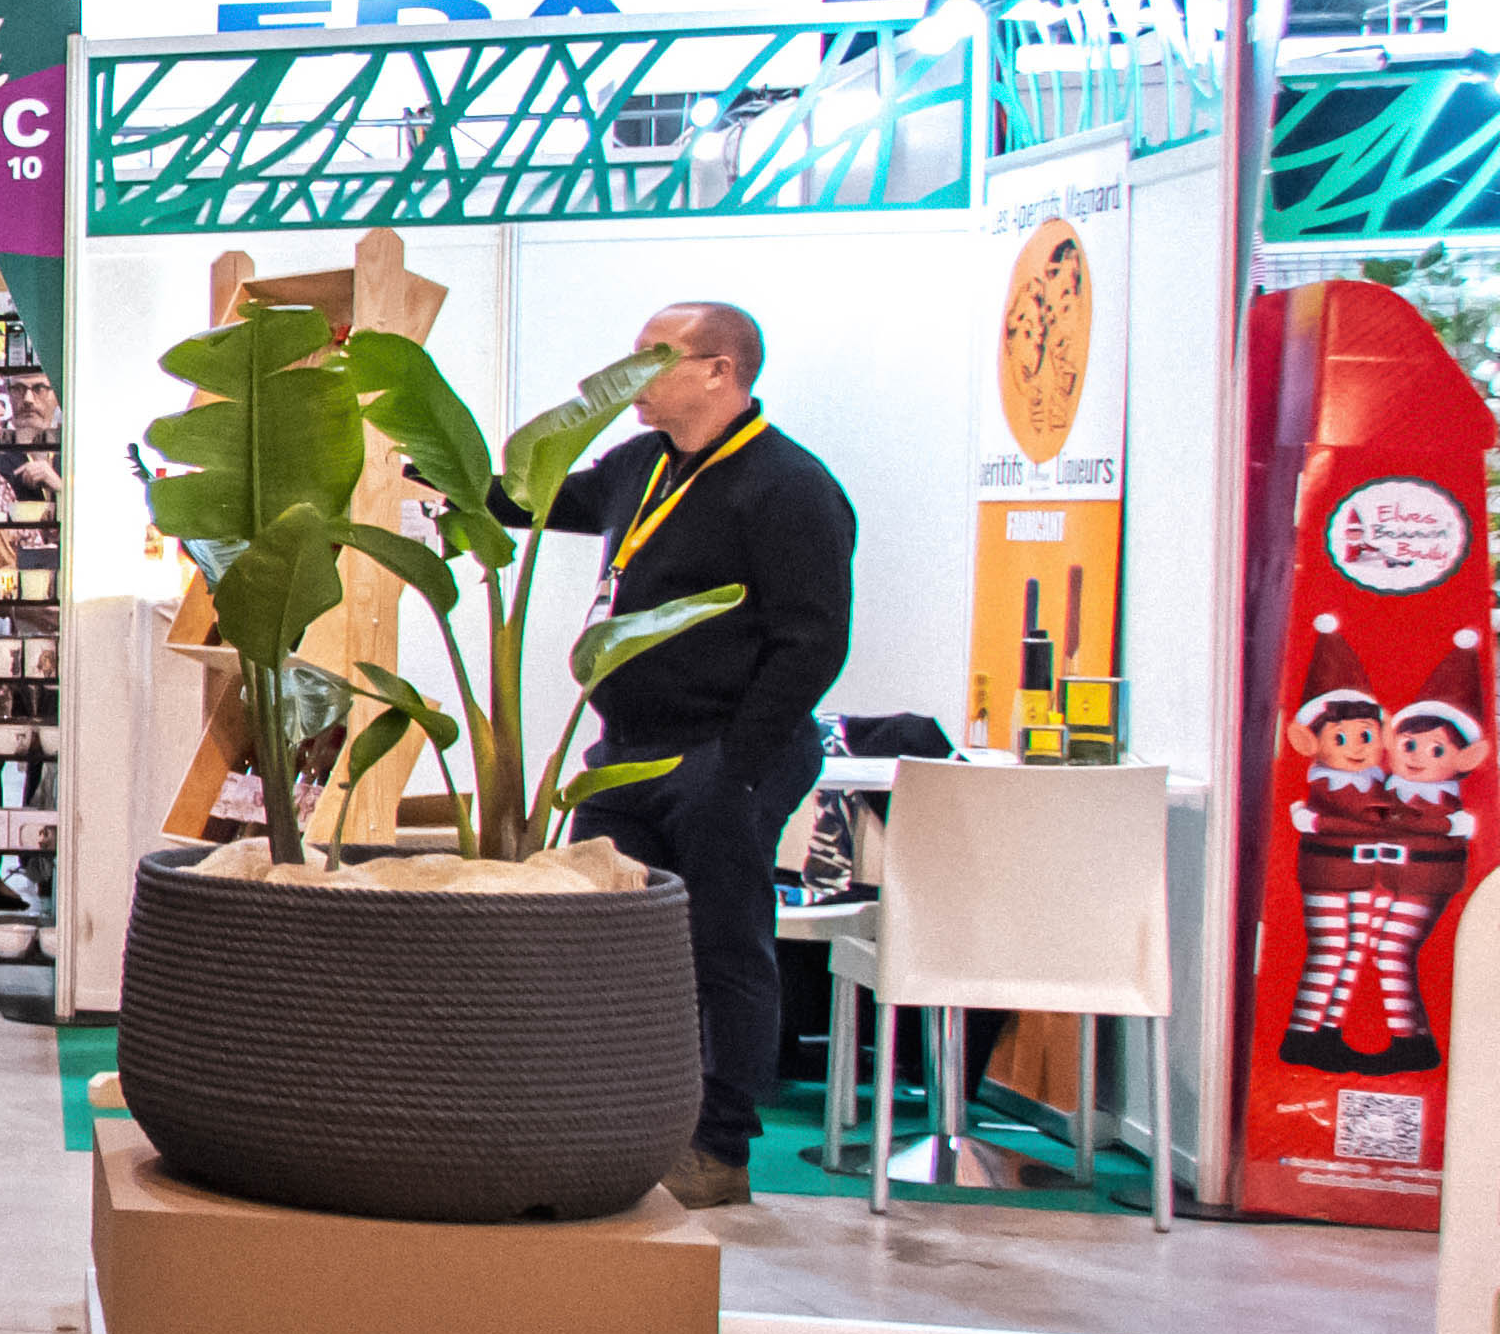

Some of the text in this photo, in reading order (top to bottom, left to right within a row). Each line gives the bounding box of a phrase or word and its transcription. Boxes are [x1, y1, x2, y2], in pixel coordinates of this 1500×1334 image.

[2, 98, 51, 148] C
[7, 155, 43, 180] 10
[1376, 502, 1437, 524] Elves
